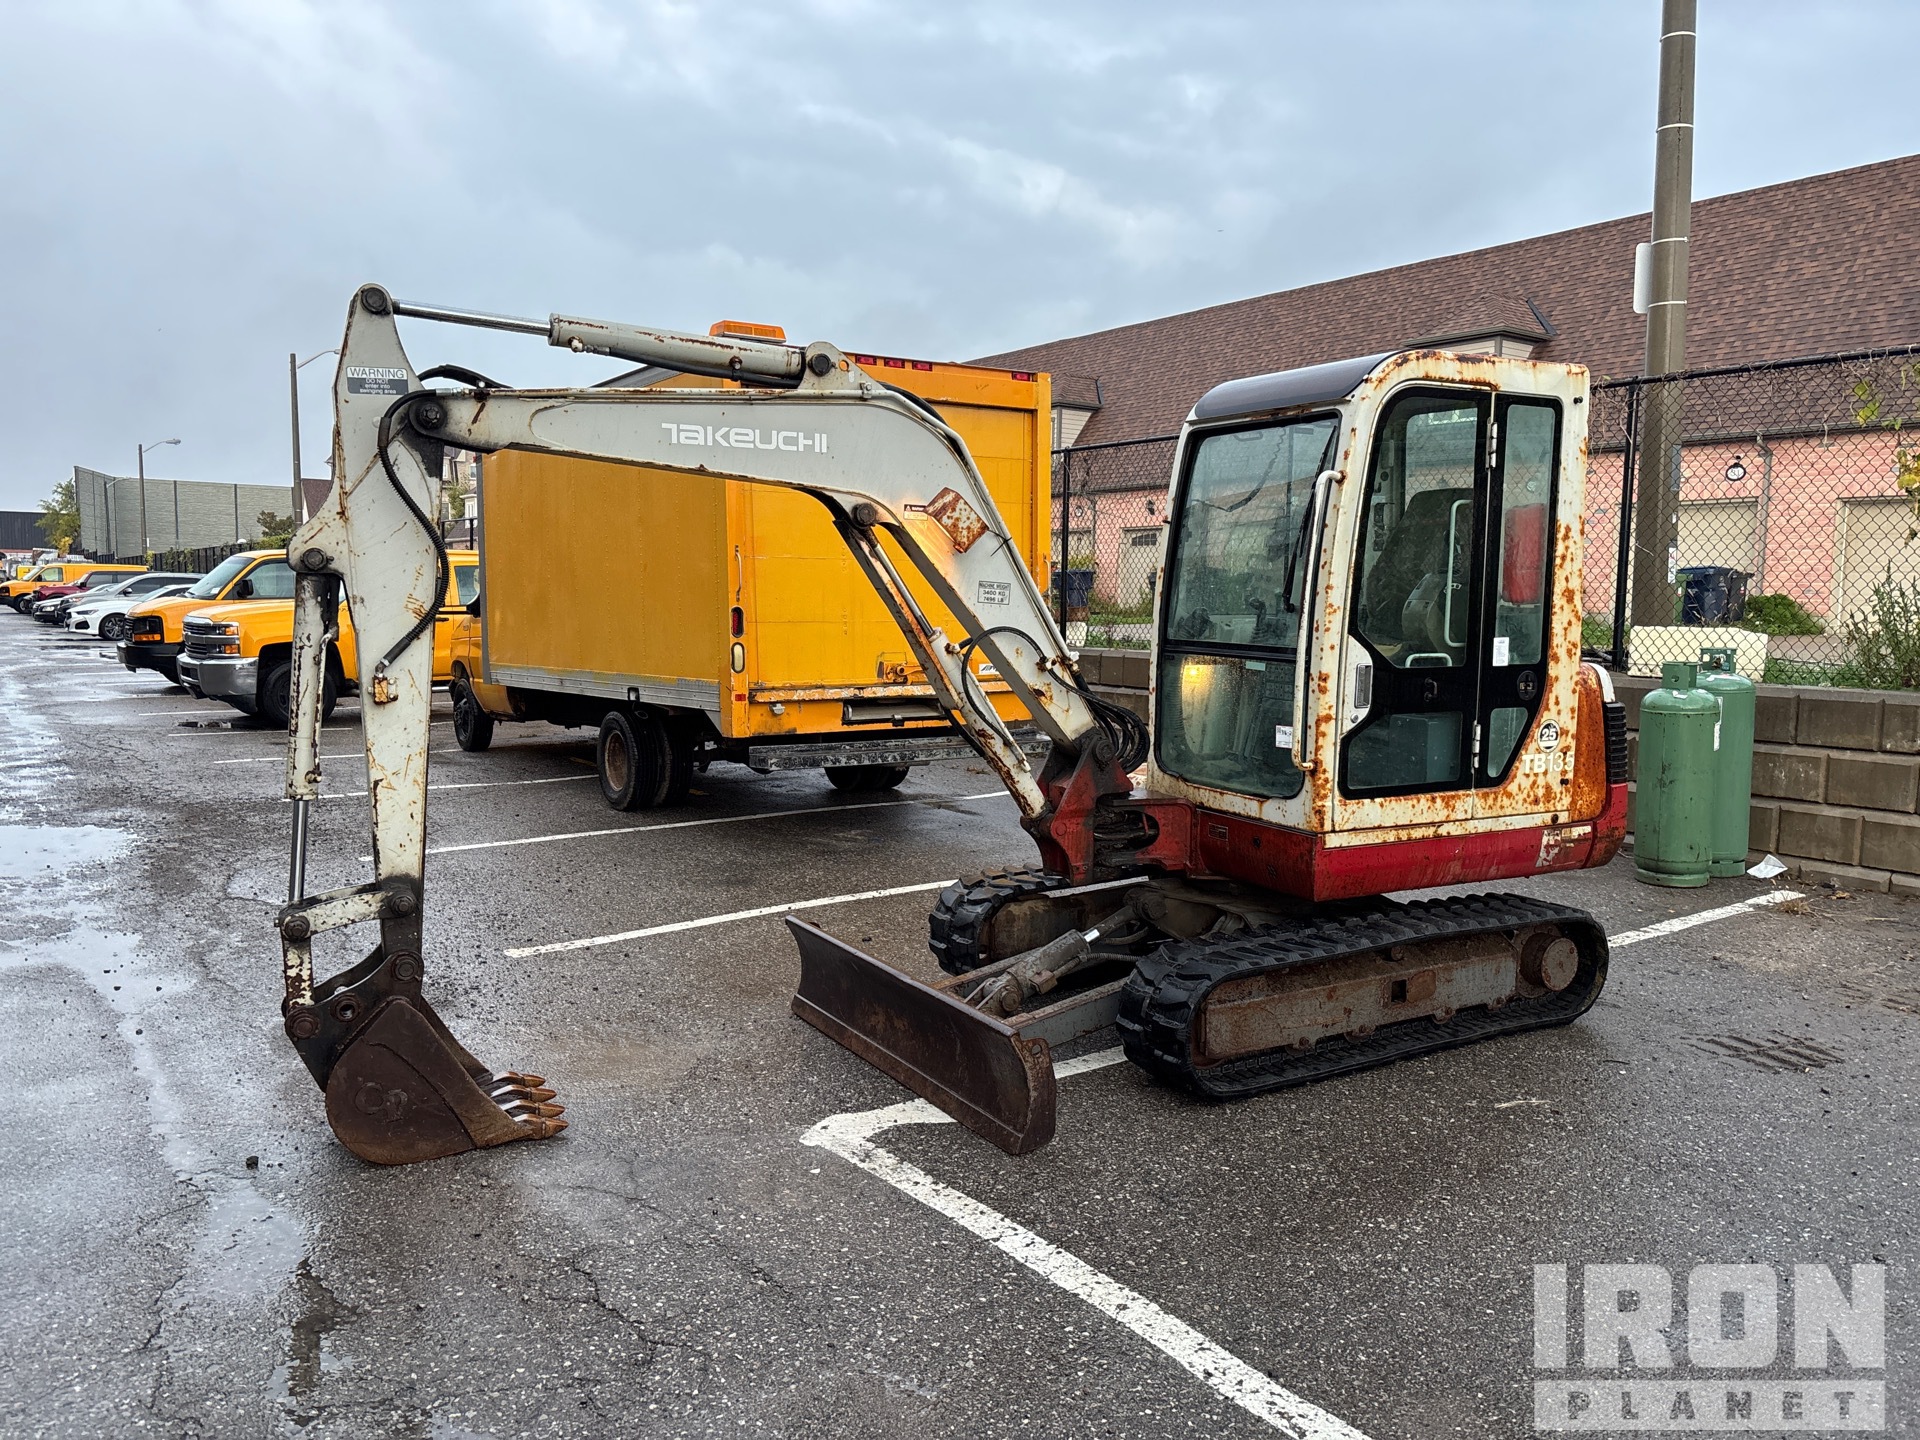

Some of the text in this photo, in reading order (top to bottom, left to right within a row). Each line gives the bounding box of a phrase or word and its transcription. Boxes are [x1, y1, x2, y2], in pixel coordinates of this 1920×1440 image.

[350, 368, 404, 378] WARNING
[661, 422, 828, 453] TAKEUCHI
[1541, 728, 1558, 741] 25
[1522, 751, 1575, 774] TB135
